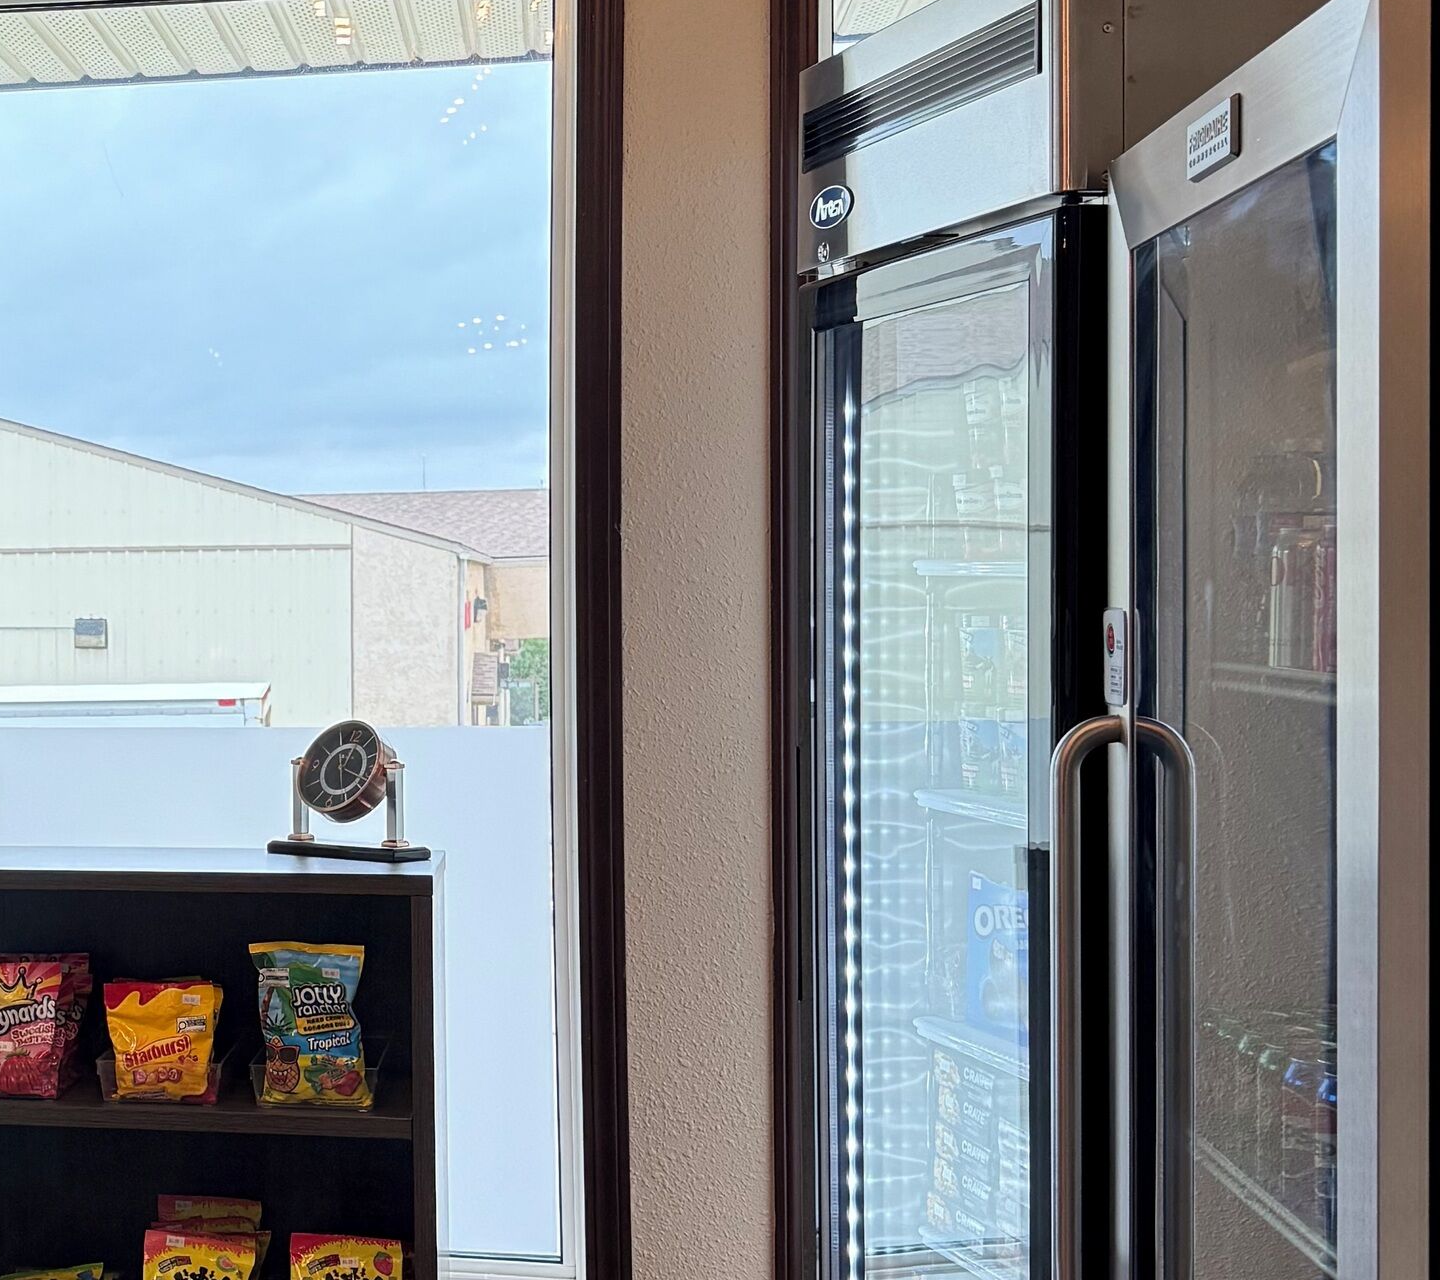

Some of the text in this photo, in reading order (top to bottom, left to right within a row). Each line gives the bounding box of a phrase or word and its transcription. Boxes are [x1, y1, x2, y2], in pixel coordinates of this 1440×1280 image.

[348, 729, 364, 744] 12
[973, 904, 1028, 937] ORE
[293, 985, 342, 1007] JOLLY
[308, 1031, 351, 1051] Tropical
